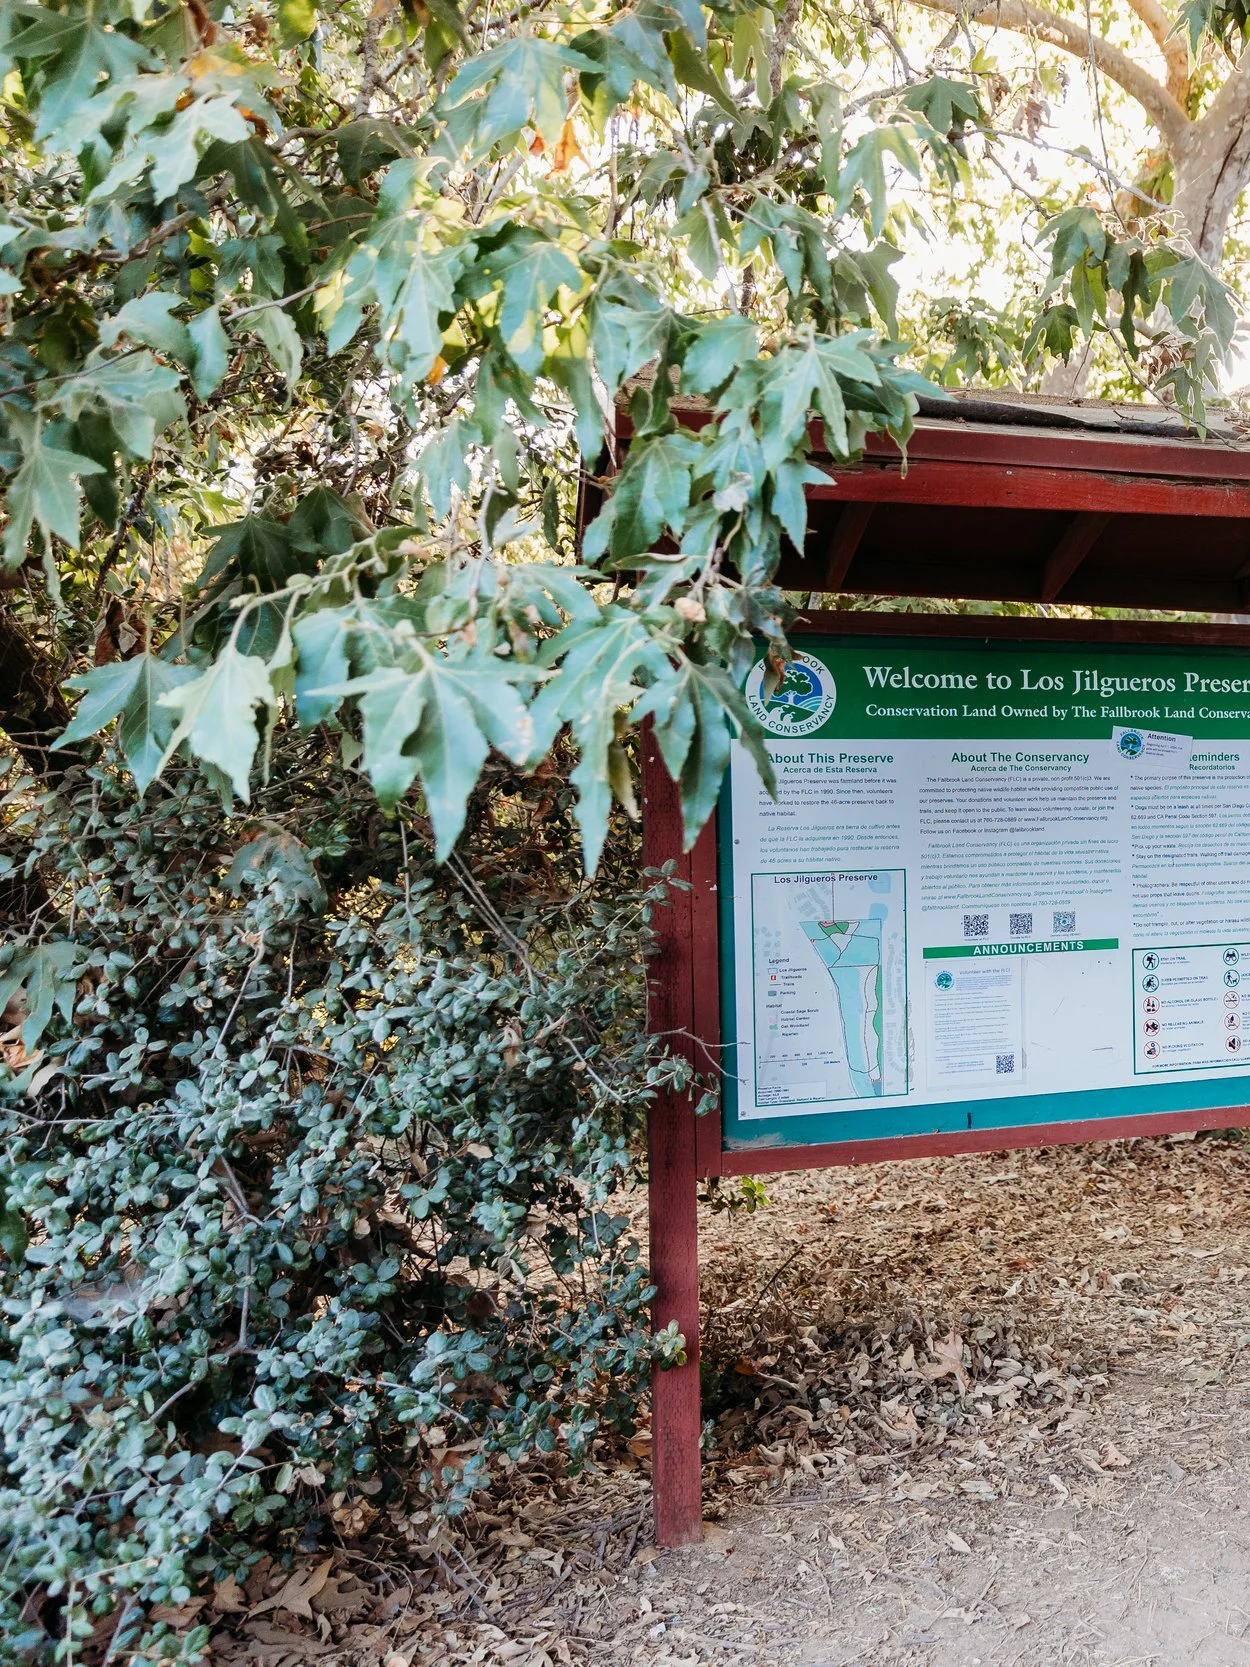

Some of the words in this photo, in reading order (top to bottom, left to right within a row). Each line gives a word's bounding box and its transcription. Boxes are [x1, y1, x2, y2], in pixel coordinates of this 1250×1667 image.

[863, 666, 977, 689] Welcome
[986, 672, 1012, 690] to
[1020, 669, 1064, 690] Los
[1072, 670, 1176, 697] Jilgueros
[749, 695, 767, 721] LAND
[769, 694, 834, 733] CONSERVANCY
[866, 704, 958, 717] Conservation
[962, 704, 996, 718] Land
[1001, 706, 1048, 718] Owned
[1052, 706, 1068, 720] by
[1072, 706, 1096, 718] The
[1100, 706, 1161, 718] Fallbrook
[1164, 707, 1195, 719] Land
[1147, 733, 1176, 742] Attention
[808, 753, 834, 763] This
[840, 753, 893, 763] Preserve
[952, 753, 987, 762] About
[991, 752, 1012, 762] The
[1015, 752, 1089, 764] Conservancy
[1190, 752, 1240, 762] eminders
[1025, 764, 1071, 772] Conservancy
[774, 876, 790, 884] Los
[794, 874, 836, 885] Jilgueros
[839, 873, 878, 882] Preserve
[973, 941, 1084, 955] ANNOUNCEMENTS
